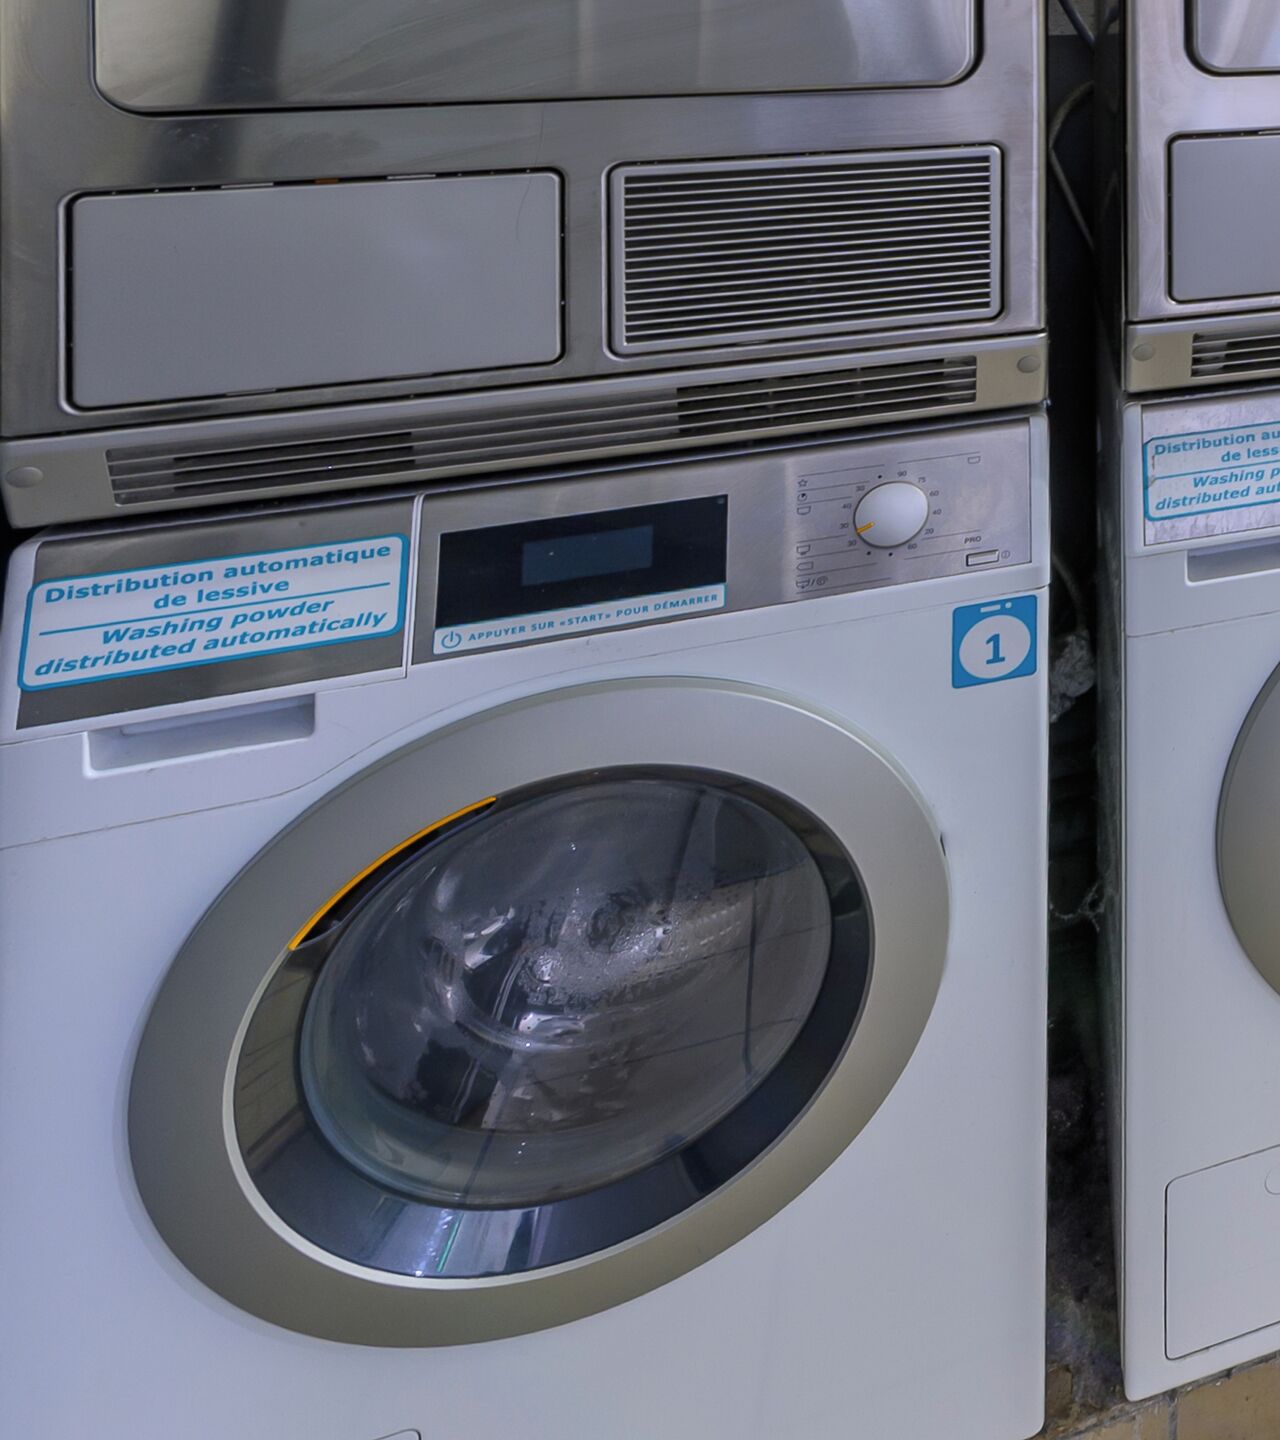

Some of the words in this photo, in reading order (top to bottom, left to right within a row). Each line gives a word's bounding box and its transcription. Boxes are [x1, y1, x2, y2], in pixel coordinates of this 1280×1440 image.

[1155, 434, 1255, 455] Distribution
[1221, 451, 1241, 462] de
[1193, 470, 1264, 488] Washing
[1155, 486, 1250, 510] distributed
[964, 536, 981, 544] PRO
[46, 570, 212, 603] Distribution
[224, 545, 391, 579] automatique
[154, 592, 186, 610] de
[197, 578, 289, 604] lessive
[102, 615, 223, 645] Washing
[231, 598, 334, 629] powder
[468, 625, 526, 641] APPUYER
[531, 620, 554, 632] SUR
[559, 613, 611, 627] «START»
[616, 606, 649, 618] POUR
[654, 594, 718, 611] DÉMARRER
[35, 637, 195, 677] distributed
[203, 611, 387, 651] automatically
[986, 633, 1005, 664] 1
